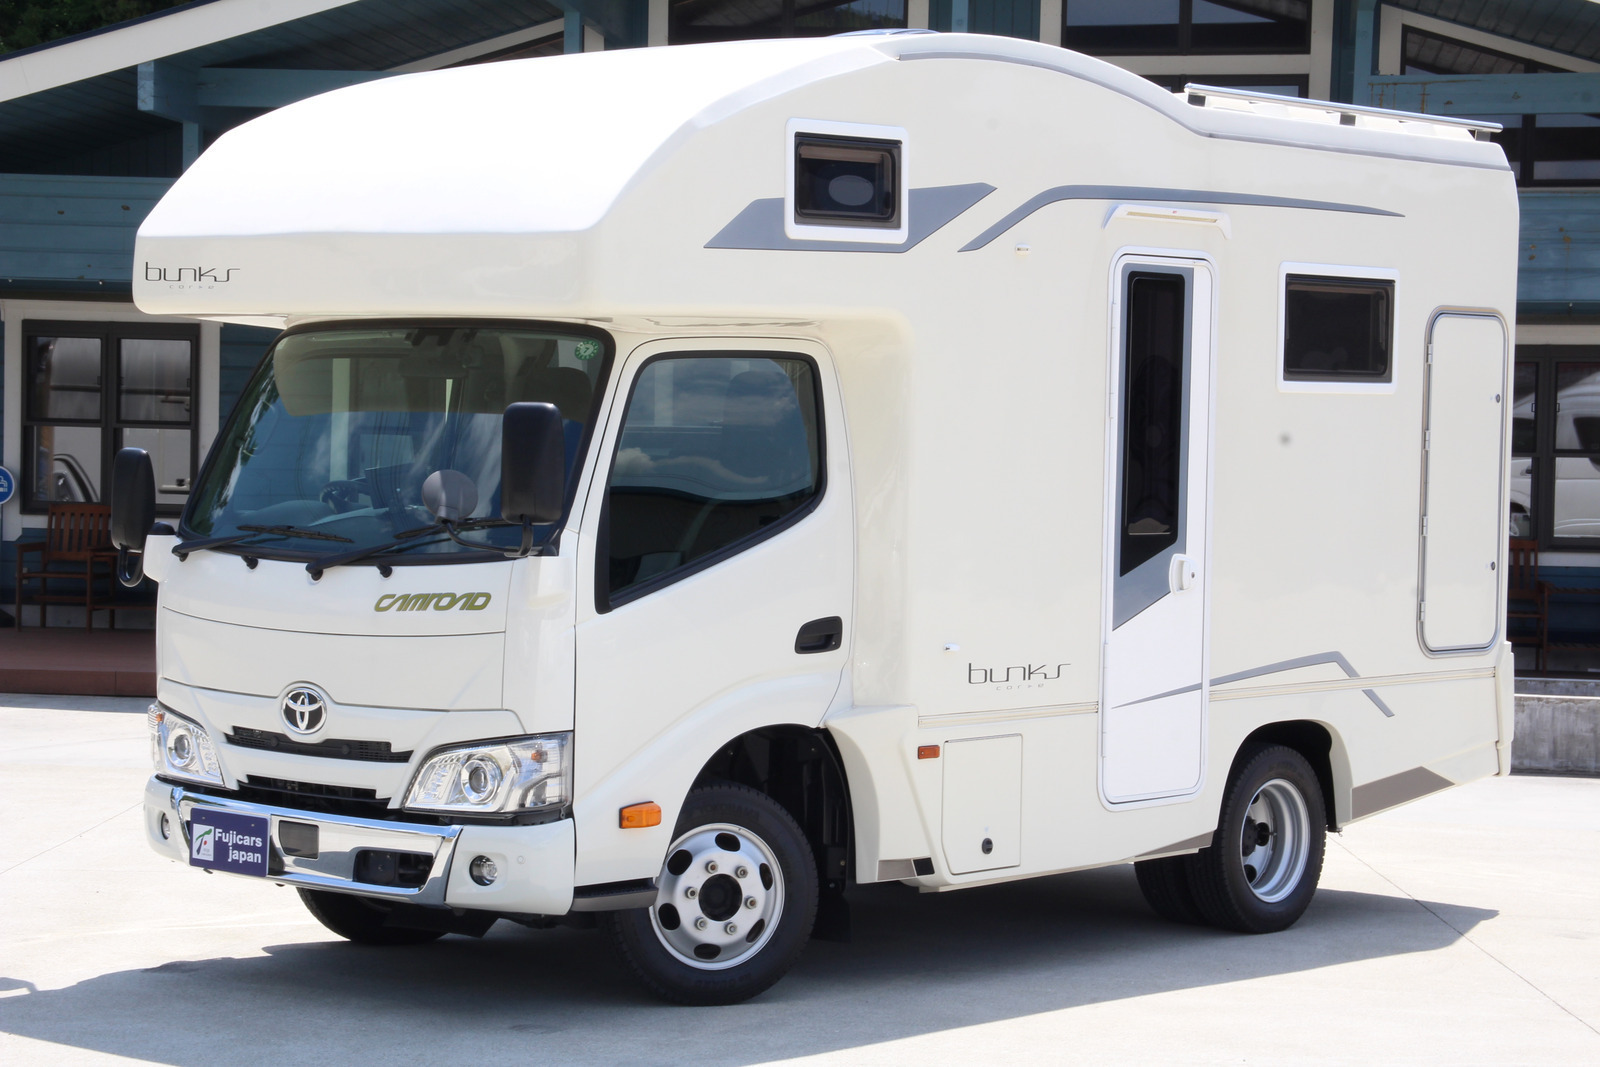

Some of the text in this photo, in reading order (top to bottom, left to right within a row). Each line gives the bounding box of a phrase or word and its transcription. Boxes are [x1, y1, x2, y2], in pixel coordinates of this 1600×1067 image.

[145, 261, 240, 283] bunks
[374, 592, 492, 612] CAMROAD
[968, 662, 1071, 684] bunks
[215, 828, 263, 848] Fujicars
[227, 846, 262, 864] japan
